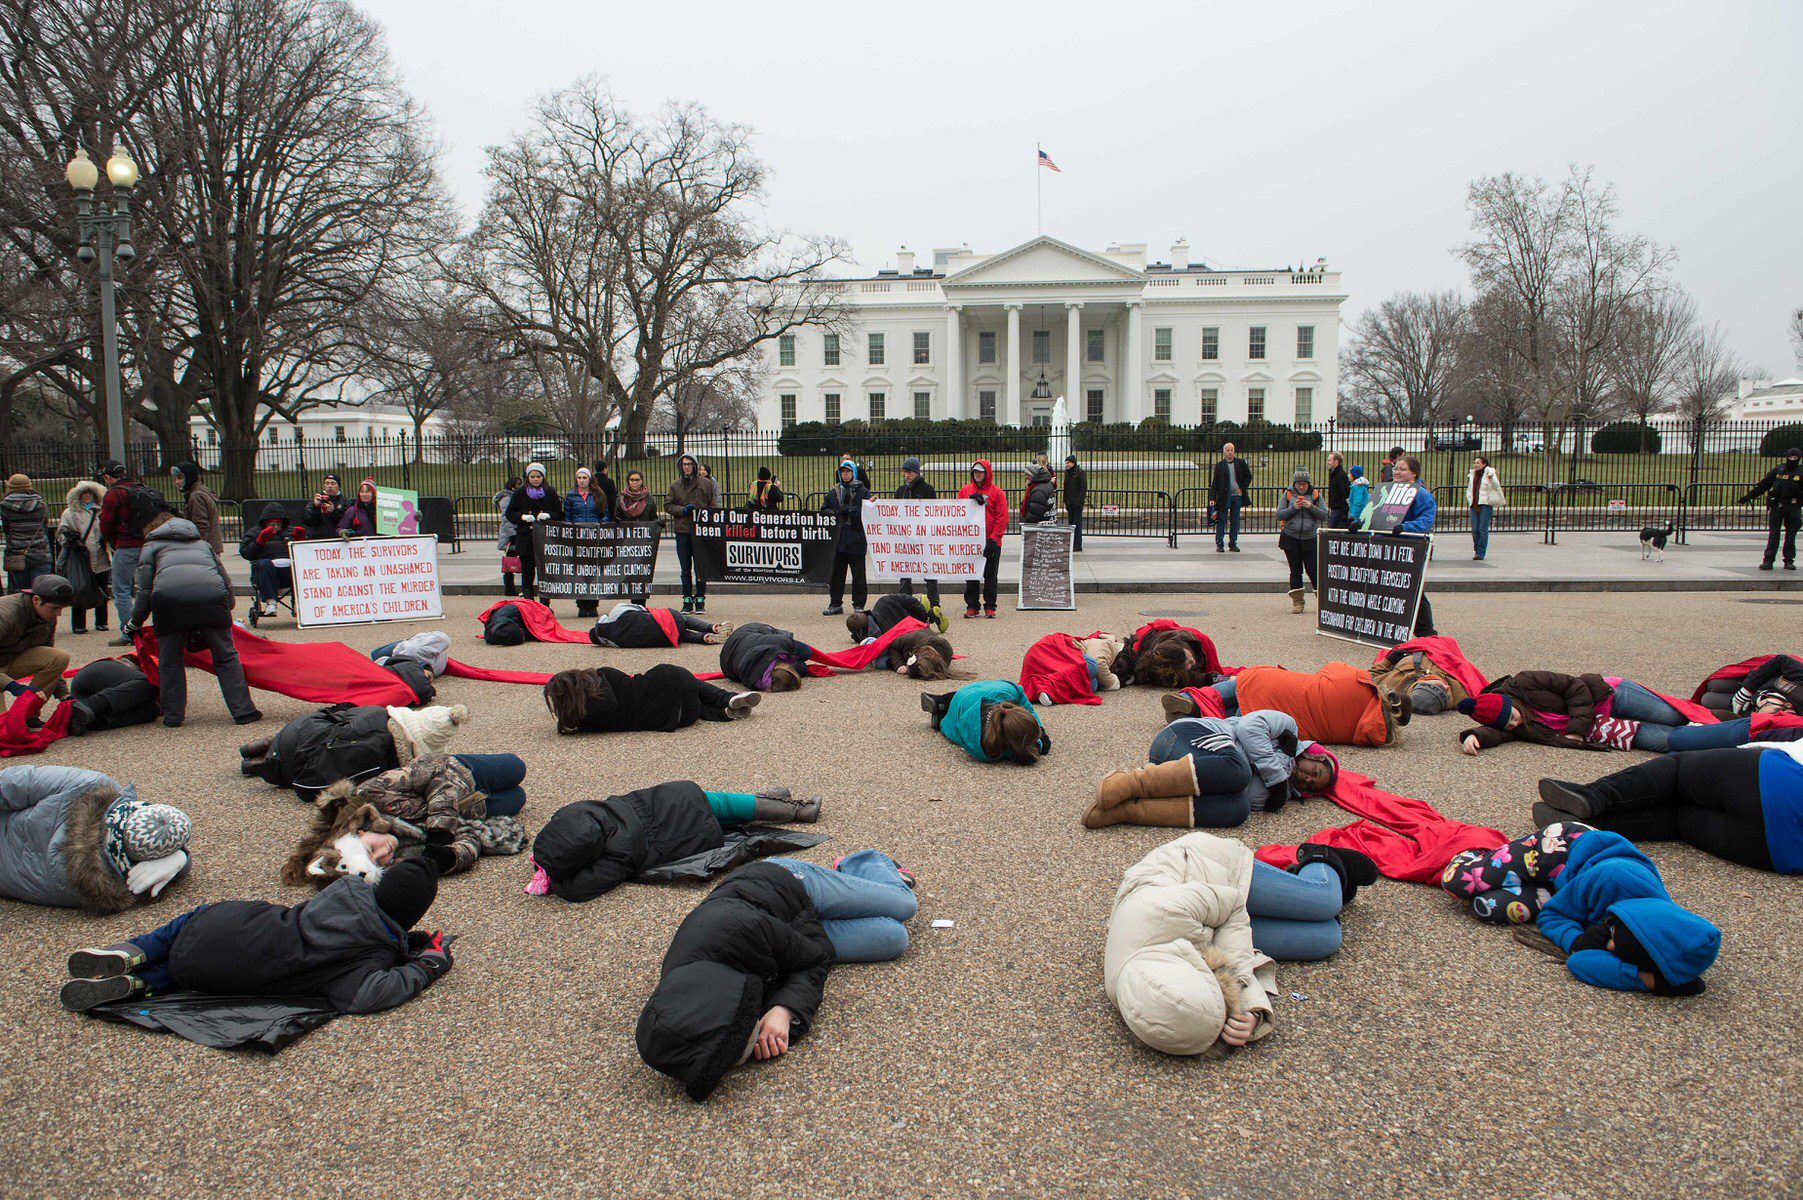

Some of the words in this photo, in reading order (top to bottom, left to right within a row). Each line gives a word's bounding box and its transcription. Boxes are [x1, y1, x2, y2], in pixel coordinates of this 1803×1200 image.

[1385, 483, 1418, 505] life
[692, 509, 709, 522] 1/3
[713, 510, 725, 522] of
[729, 510, 748, 523] Our
[753, 511, 814, 525] Generation
[816, 513, 837, 526] has
[905, 505, 920, 517] THE
[925, 505, 966, 517] SURVIVORS
[545, 525, 560, 537] THEY
[562, 527, 573, 539] ARE
[576, 527, 597, 540] LAYING
[599, 528, 614, 540] DOWN
[616, 527, 624, 539] IN
[626, 527, 631, 538] A
[633, 527, 652, 539] FETAL
[695, 524, 721, 537] been
[725, 524, 757, 538] killed
[760, 525, 797, 539] before
[802, 527, 832, 540] birth.
[866, 524, 882, 536] ARE
[886, 524, 912, 536] TAKING
[916, 525, 927, 536] AN
[931, 525, 980, 536] UNASHAMED
[348, 547, 366, 558] THE
[371, 544, 418, 558] SURVIVORS
[544, 543, 574, 557] POSITION
[576, 545, 614, 558] IDENTIFYING
[616, 545, 652, 557] THEMSELVES
[729, 545, 799, 566] SURVIVORS
[870, 543, 891, 554] TAND
[894, 543, 924, 555] AGAINST
[928, 543, 945, 555] THE
[949, 544, 982, 556] MURDER
[1328, 540, 1340, 555] THEY
[1340, 541, 1350, 556] ARE
[1397, 546, 1415, 563] FETAL
[303, 568, 321, 580] ARE
[326, 566, 359, 579] TAKING
[363, 565, 376, 577] AN
[380, 562, 433, 576] UNASHAMED
[545, 563, 560, 575] WITH
[562, 563, 574, 575] THE
[576, 564, 601, 577] UNBORN
[603, 564, 621, 577] WHILE
[623, 563, 651, 576] CLAIMING
[891, 561, 928, 574] AMERICA'S
[932, 562, 976, 575] CHILDREN.
[1328, 563, 1349, 581] POSITION
[1349, 566, 1379, 585] IDENTIFYING
[1380, 569, 1412, 589] THEMSELVES
[724, 575, 805, 583] WWW.SURVIVORS.LA
[303, 586, 333, 599] STAND
[337, 583, 374, 597] AGAINST
[378, 582, 396, 594] THE
[401, 580, 436, 593] MURDER
[575, 582, 588, 594] FOR
[589, 582, 619, 595] CHILDREN
[621, 582, 628, 594] IN
[631, 582, 643, 594] THE
[313, 605, 327, 618] OF
[332, 601, 378, 616] AMERICA'S
[383, 599, 430, 614] CHILDREN.
[1328, 587, 1339, 602] WITH
[1339, 588, 1348, 604] THE
[1348, 590, 1366, 608] UNBORN
[1367, 594, 1383, 611] WHILE
[1382, 596, 1406, 615] CLAIMING
[1320, 609, 1345, 628] PERSONHOOD
[1345, 615, 1355, 631] FOR
[1354, 616, 1376, 636] CHILDREN
